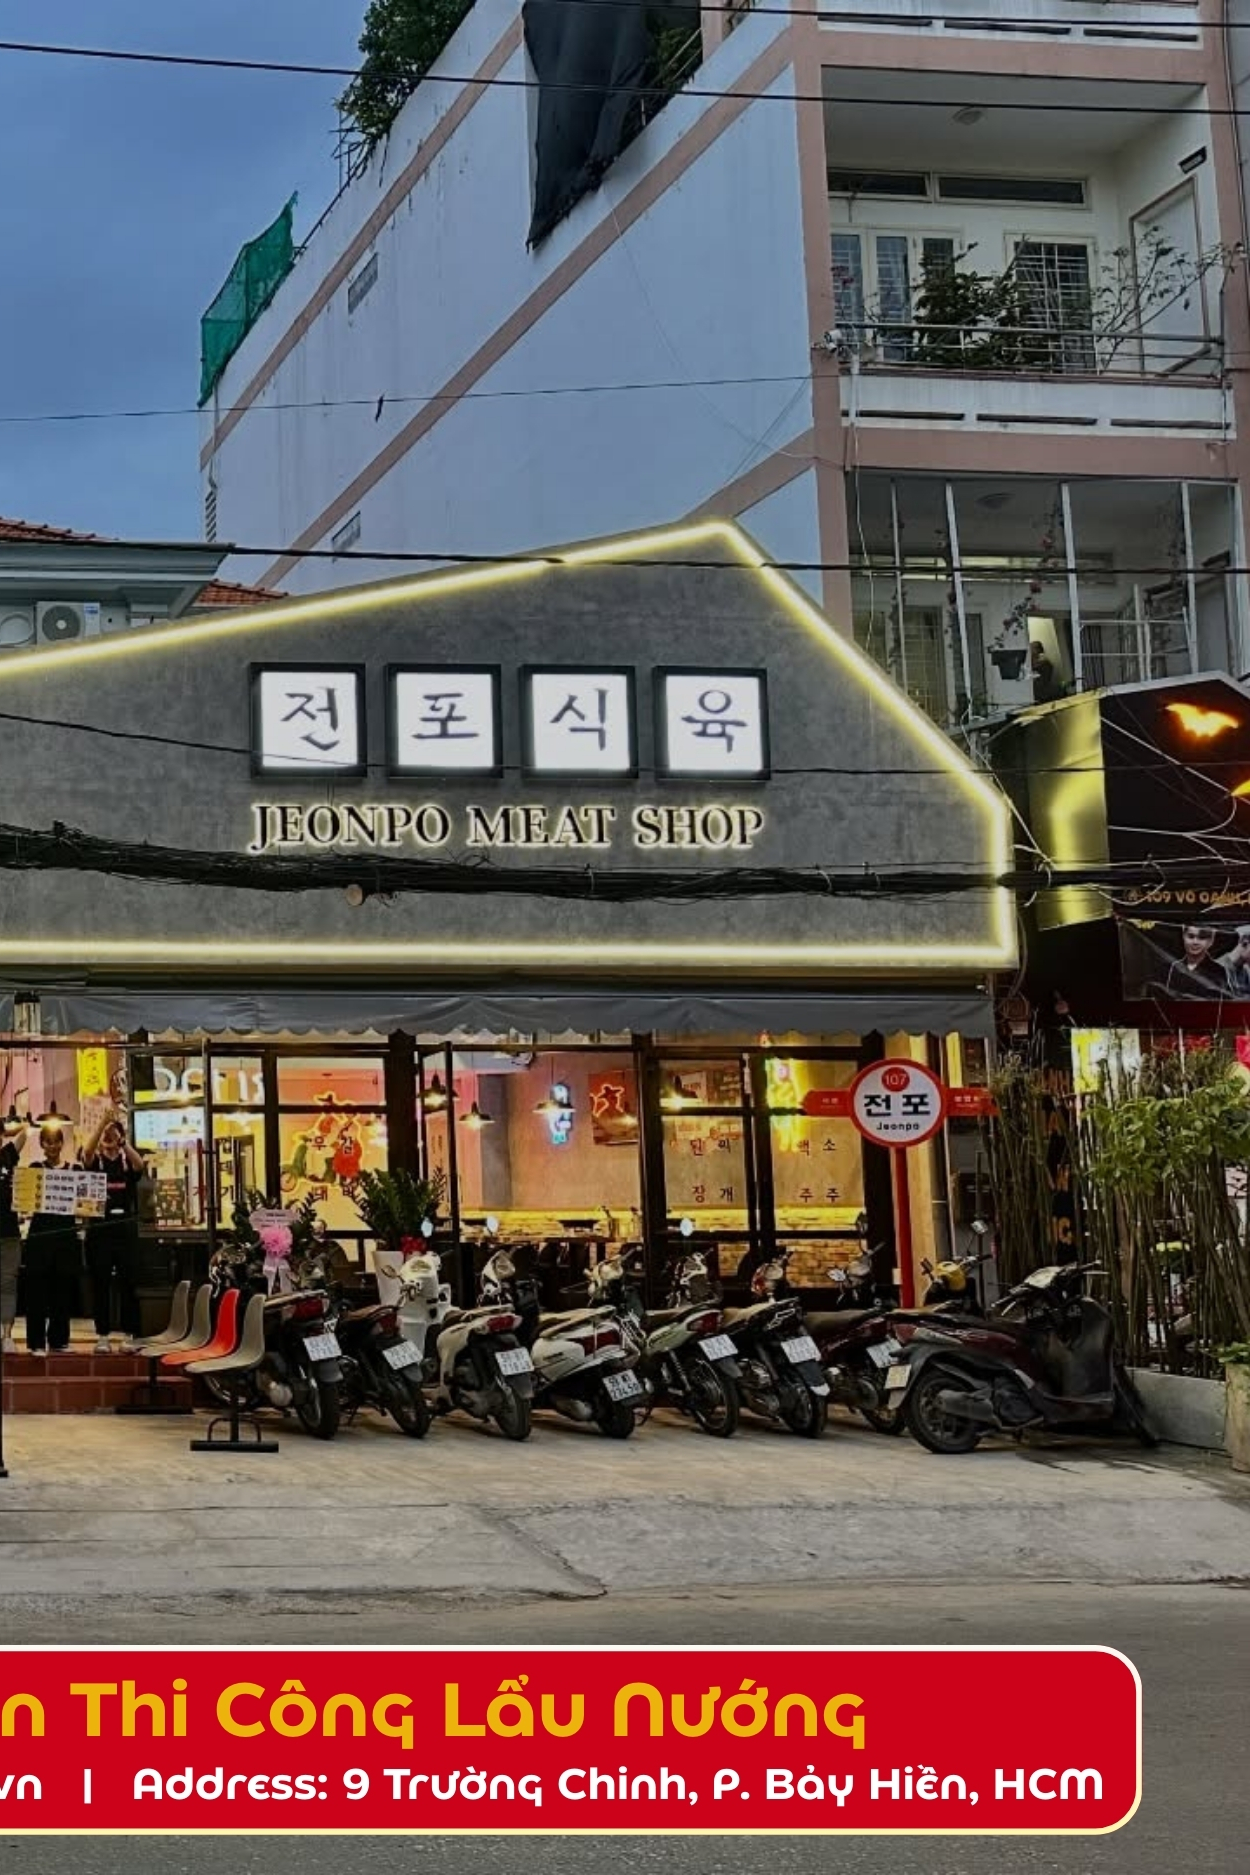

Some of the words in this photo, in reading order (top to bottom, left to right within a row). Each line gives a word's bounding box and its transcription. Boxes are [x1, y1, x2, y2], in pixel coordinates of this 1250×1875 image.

[252, 804, 451, 851] JEONPO
[467, 806, 616, 846] MEAT
[634, 805, 766, 847] SHOP
[884, 1073, 907, 1086] 107
[877, 1122, 920, 1132] Jeonpo
